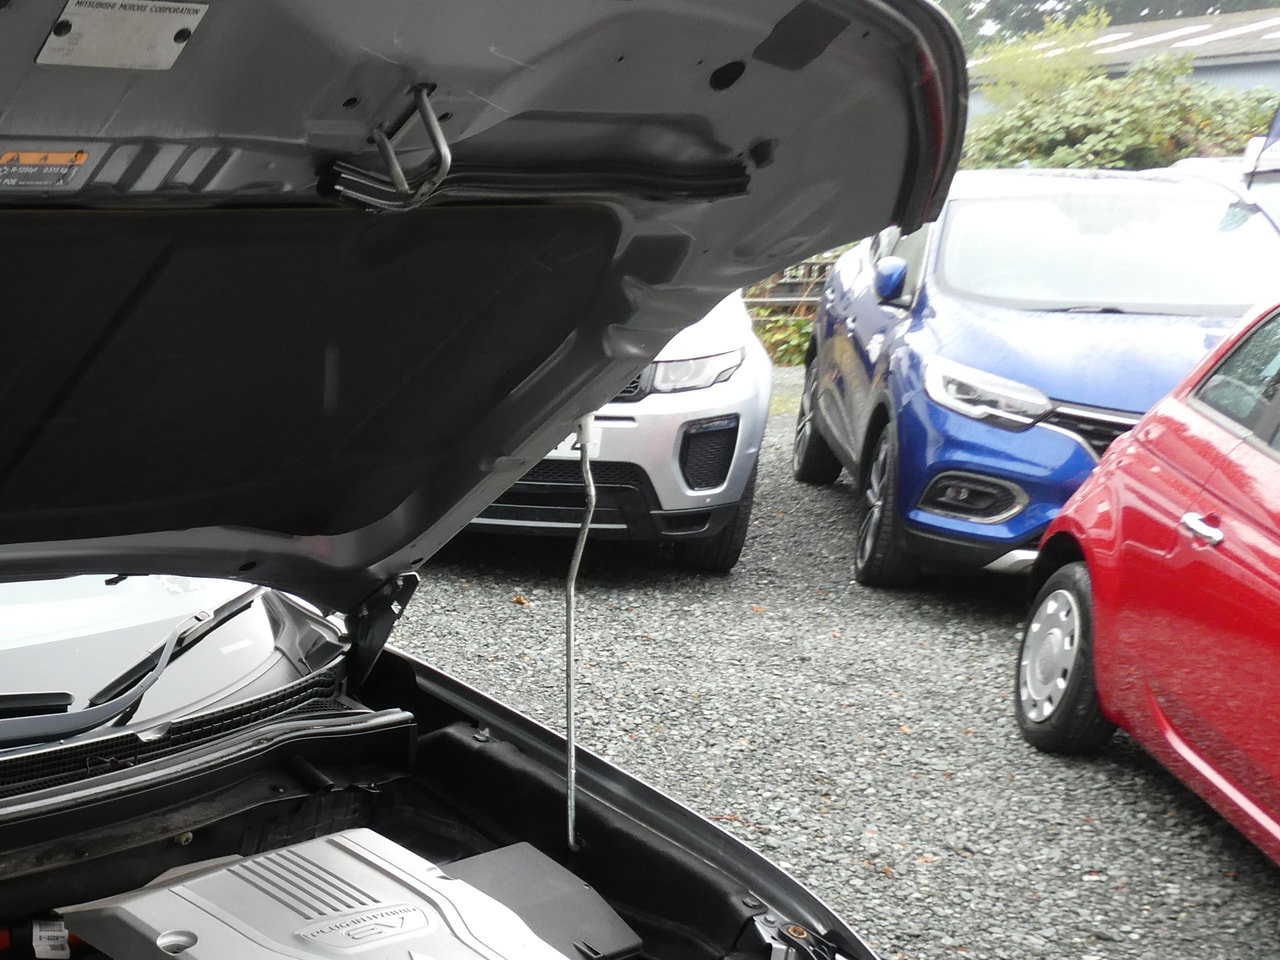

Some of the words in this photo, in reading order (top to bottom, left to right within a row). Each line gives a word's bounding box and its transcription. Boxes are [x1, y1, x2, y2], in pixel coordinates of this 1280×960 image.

[74, 0, 117, 10] MITSUBISHI
[118, 3, 148, 12] MOTORS
[149, 5, 201, 15] CORPORATION
